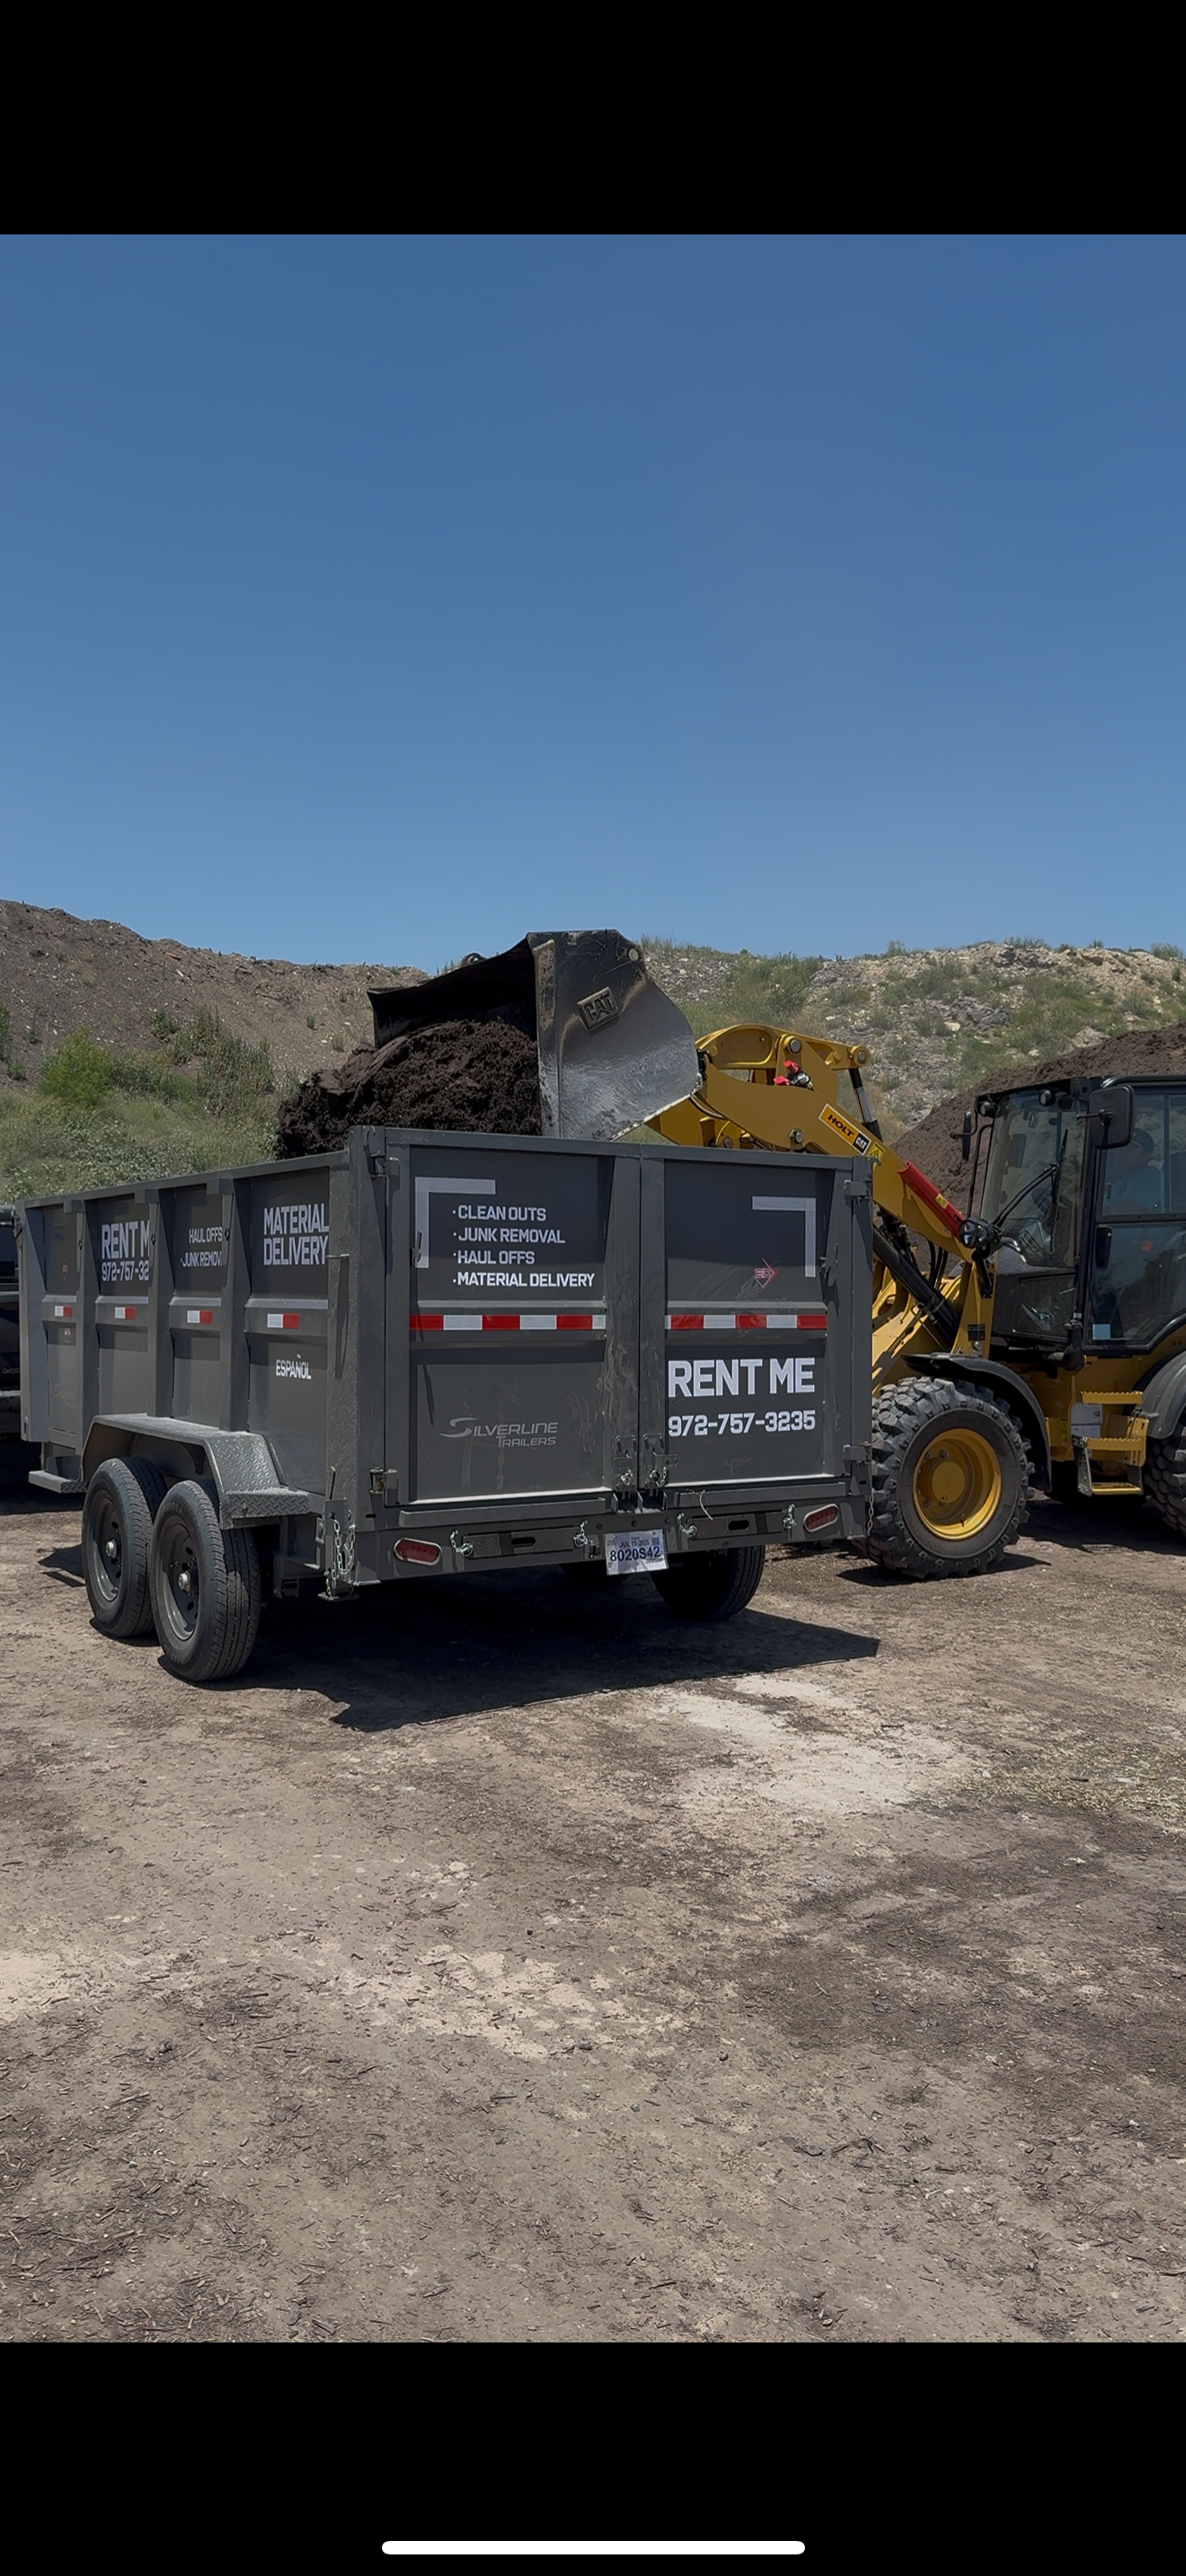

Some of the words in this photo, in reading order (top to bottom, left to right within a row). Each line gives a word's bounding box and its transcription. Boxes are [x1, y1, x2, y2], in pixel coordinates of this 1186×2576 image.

[584, 992, 615, 1022] CAT
[828, 1115, 854, 1137] HOLT
[855, 1136, 867, 1150] CAT
[263, 1204, 329, 1235] MATERIAL
[457, 1204, 506, 1221] CLEAN
[508, 1206, 547, 1222] OUTS
[102, 1222, 138, 1259] RENT
[140, 1220, 150, 1257] M
[189, 1228, 206, 1244] HAUL
[207, 1227, 223, 1242] OFFS
[457, 1227, 498, 1242] JUNK
[500, 1229, 566, 1244] REMOVAL
[182, 1251, 199, 1267] JUNK
[199, 1251, 223, 1267] REMOV
[263, 1236, 329, 1266] DELIVERY
[457, 1249, 497, 1265] HAUL
[499, 1250, 535, 1265] OFFS
[102, 1260, 150, 1282] 972-757-32
[457, 1271, 527, 1287] MATERIAL
[529, 1273, 596, 1287] DELIVERY
[275, 1353, 312, 1381] ESPAÑOL
[668, 1359, 764, 1398] RENT
[769, 1357, 816, 1394] ME
[438, 1417, 559, 1438] SILVERLINE
[668, 1410, 816, 1437] 972-757-3235
[496, 1436, 557, 1448] TRAILERS
[610, 1545, 661, 1562] 8020S42
